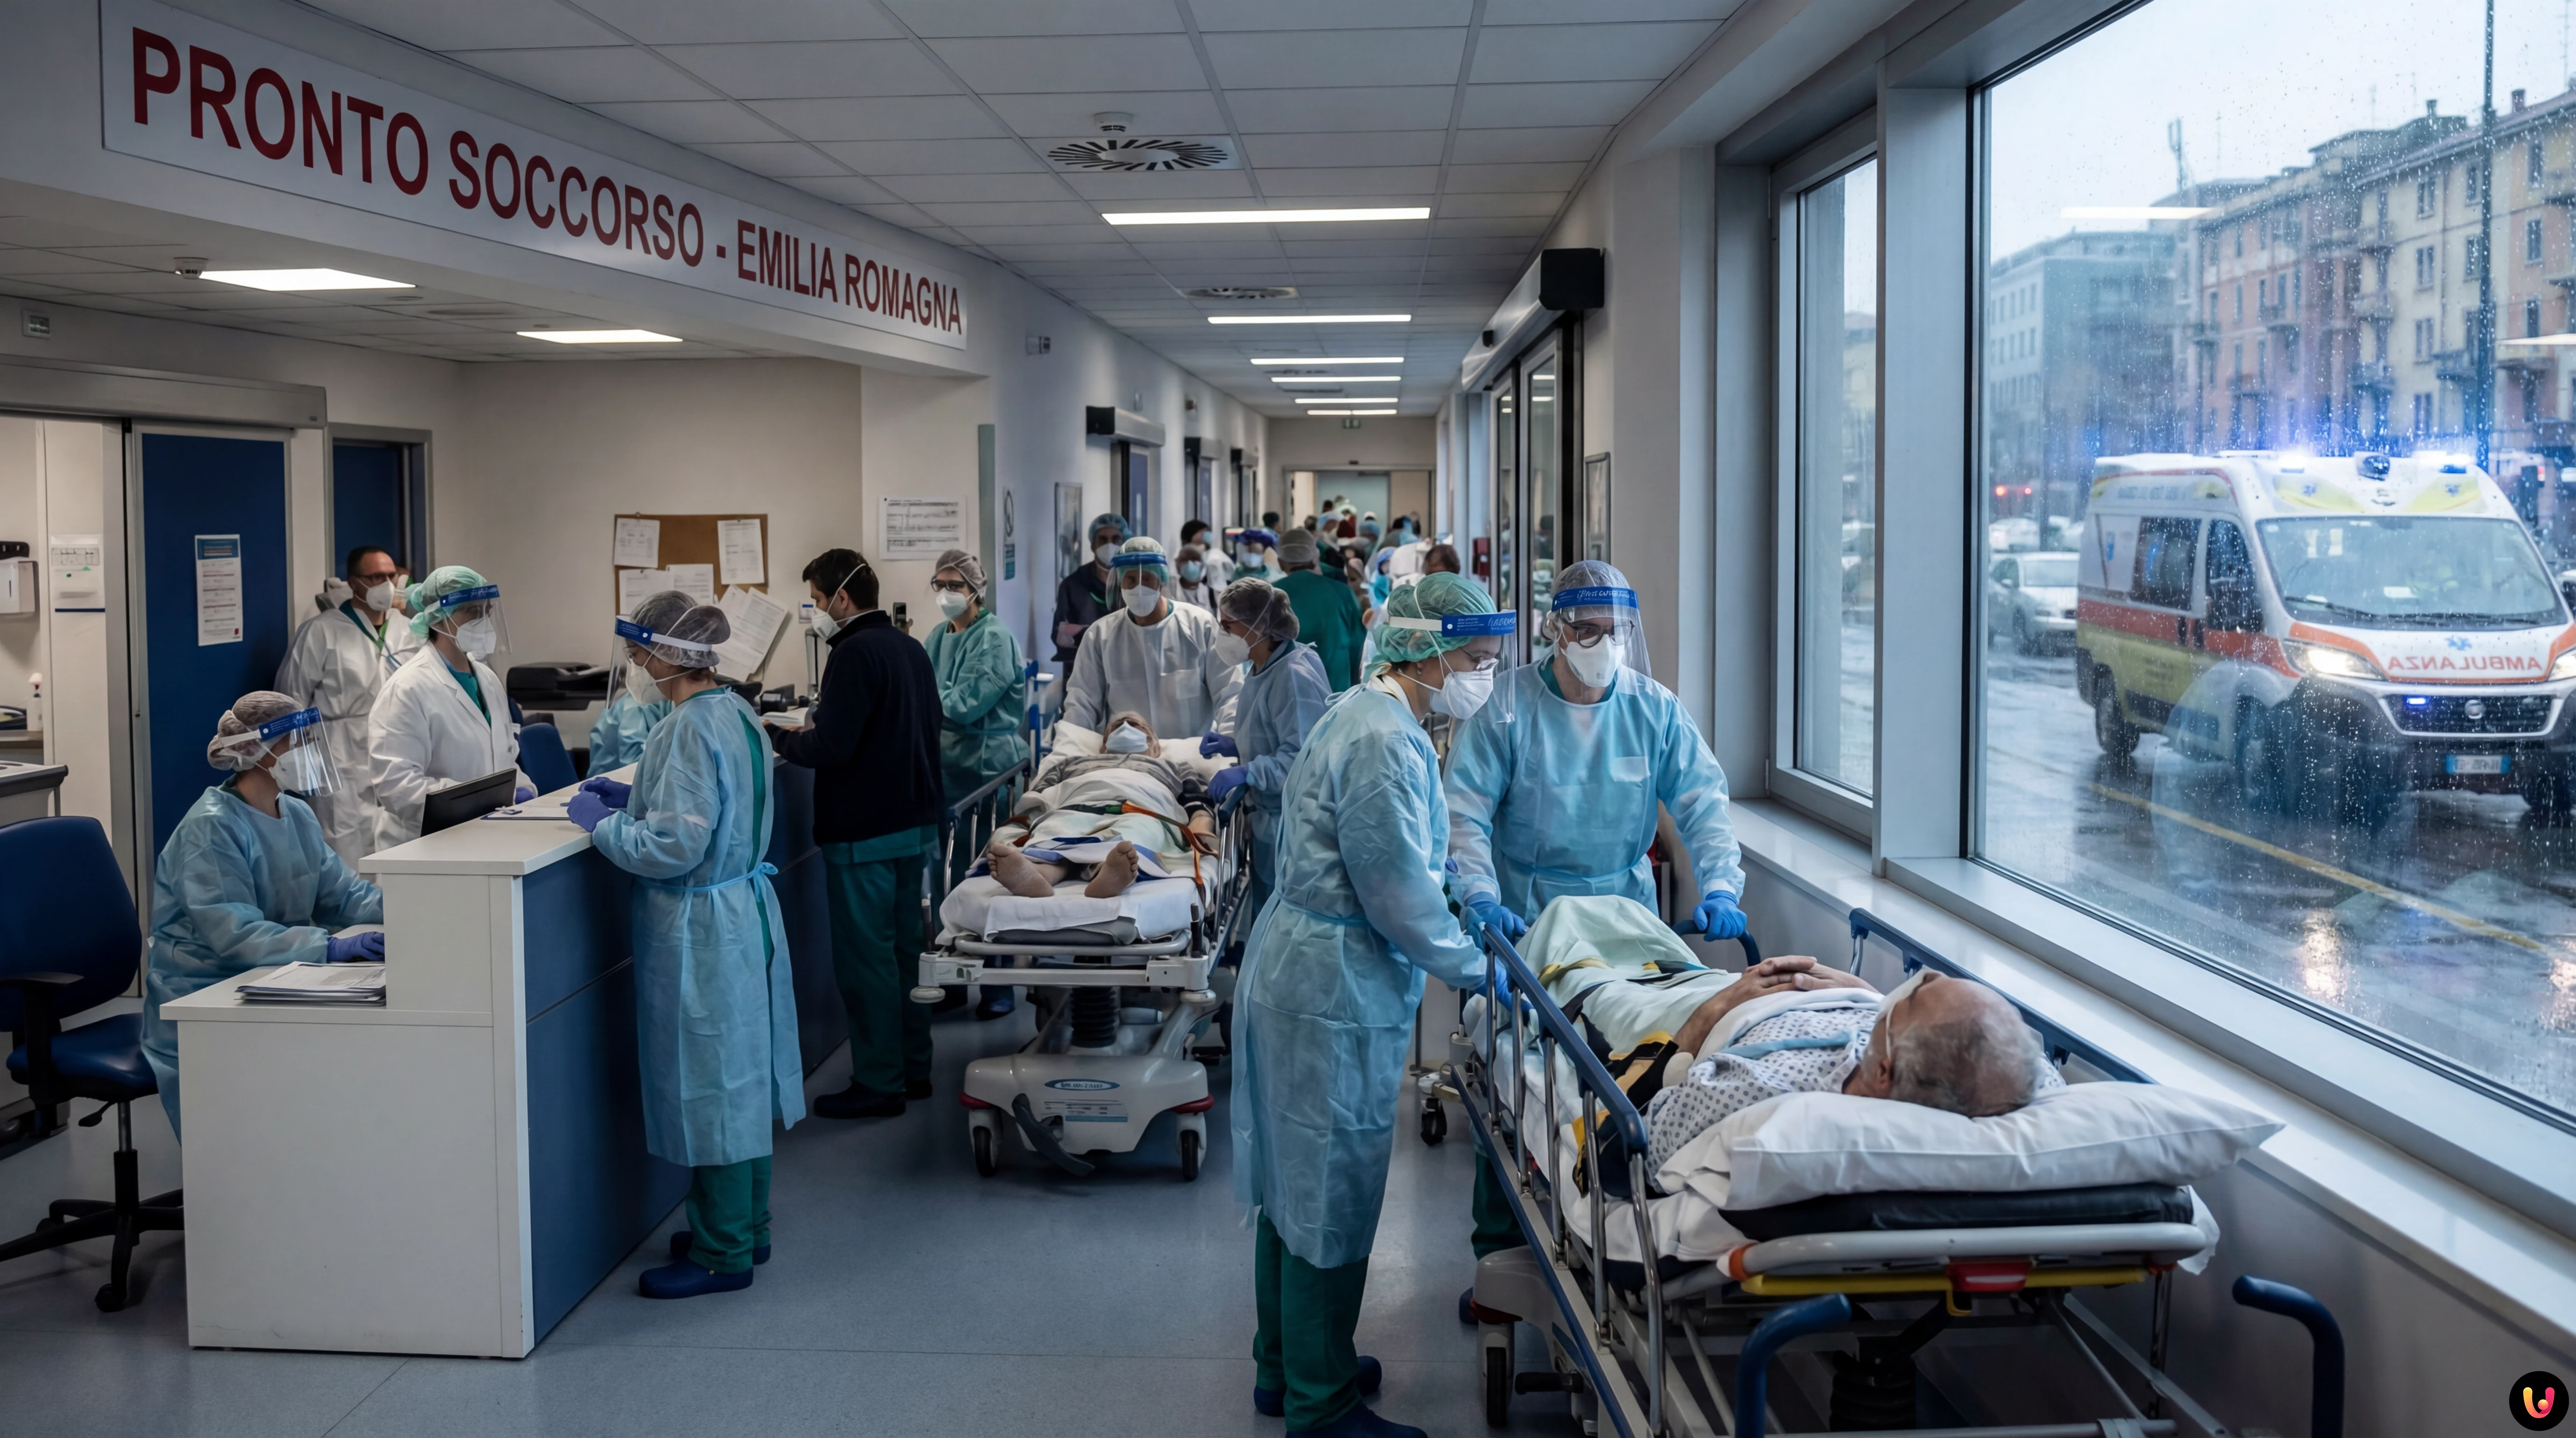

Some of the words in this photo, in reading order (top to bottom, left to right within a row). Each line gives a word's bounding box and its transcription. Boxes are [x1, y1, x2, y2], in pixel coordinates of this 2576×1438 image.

[133, 27, 429, 196] PRONTO
[449, 131, 703, 267] SOCCORSO
[738, 220, 838, 302] EMILIA
[845, 255, 962, 336] ROMAGNA
